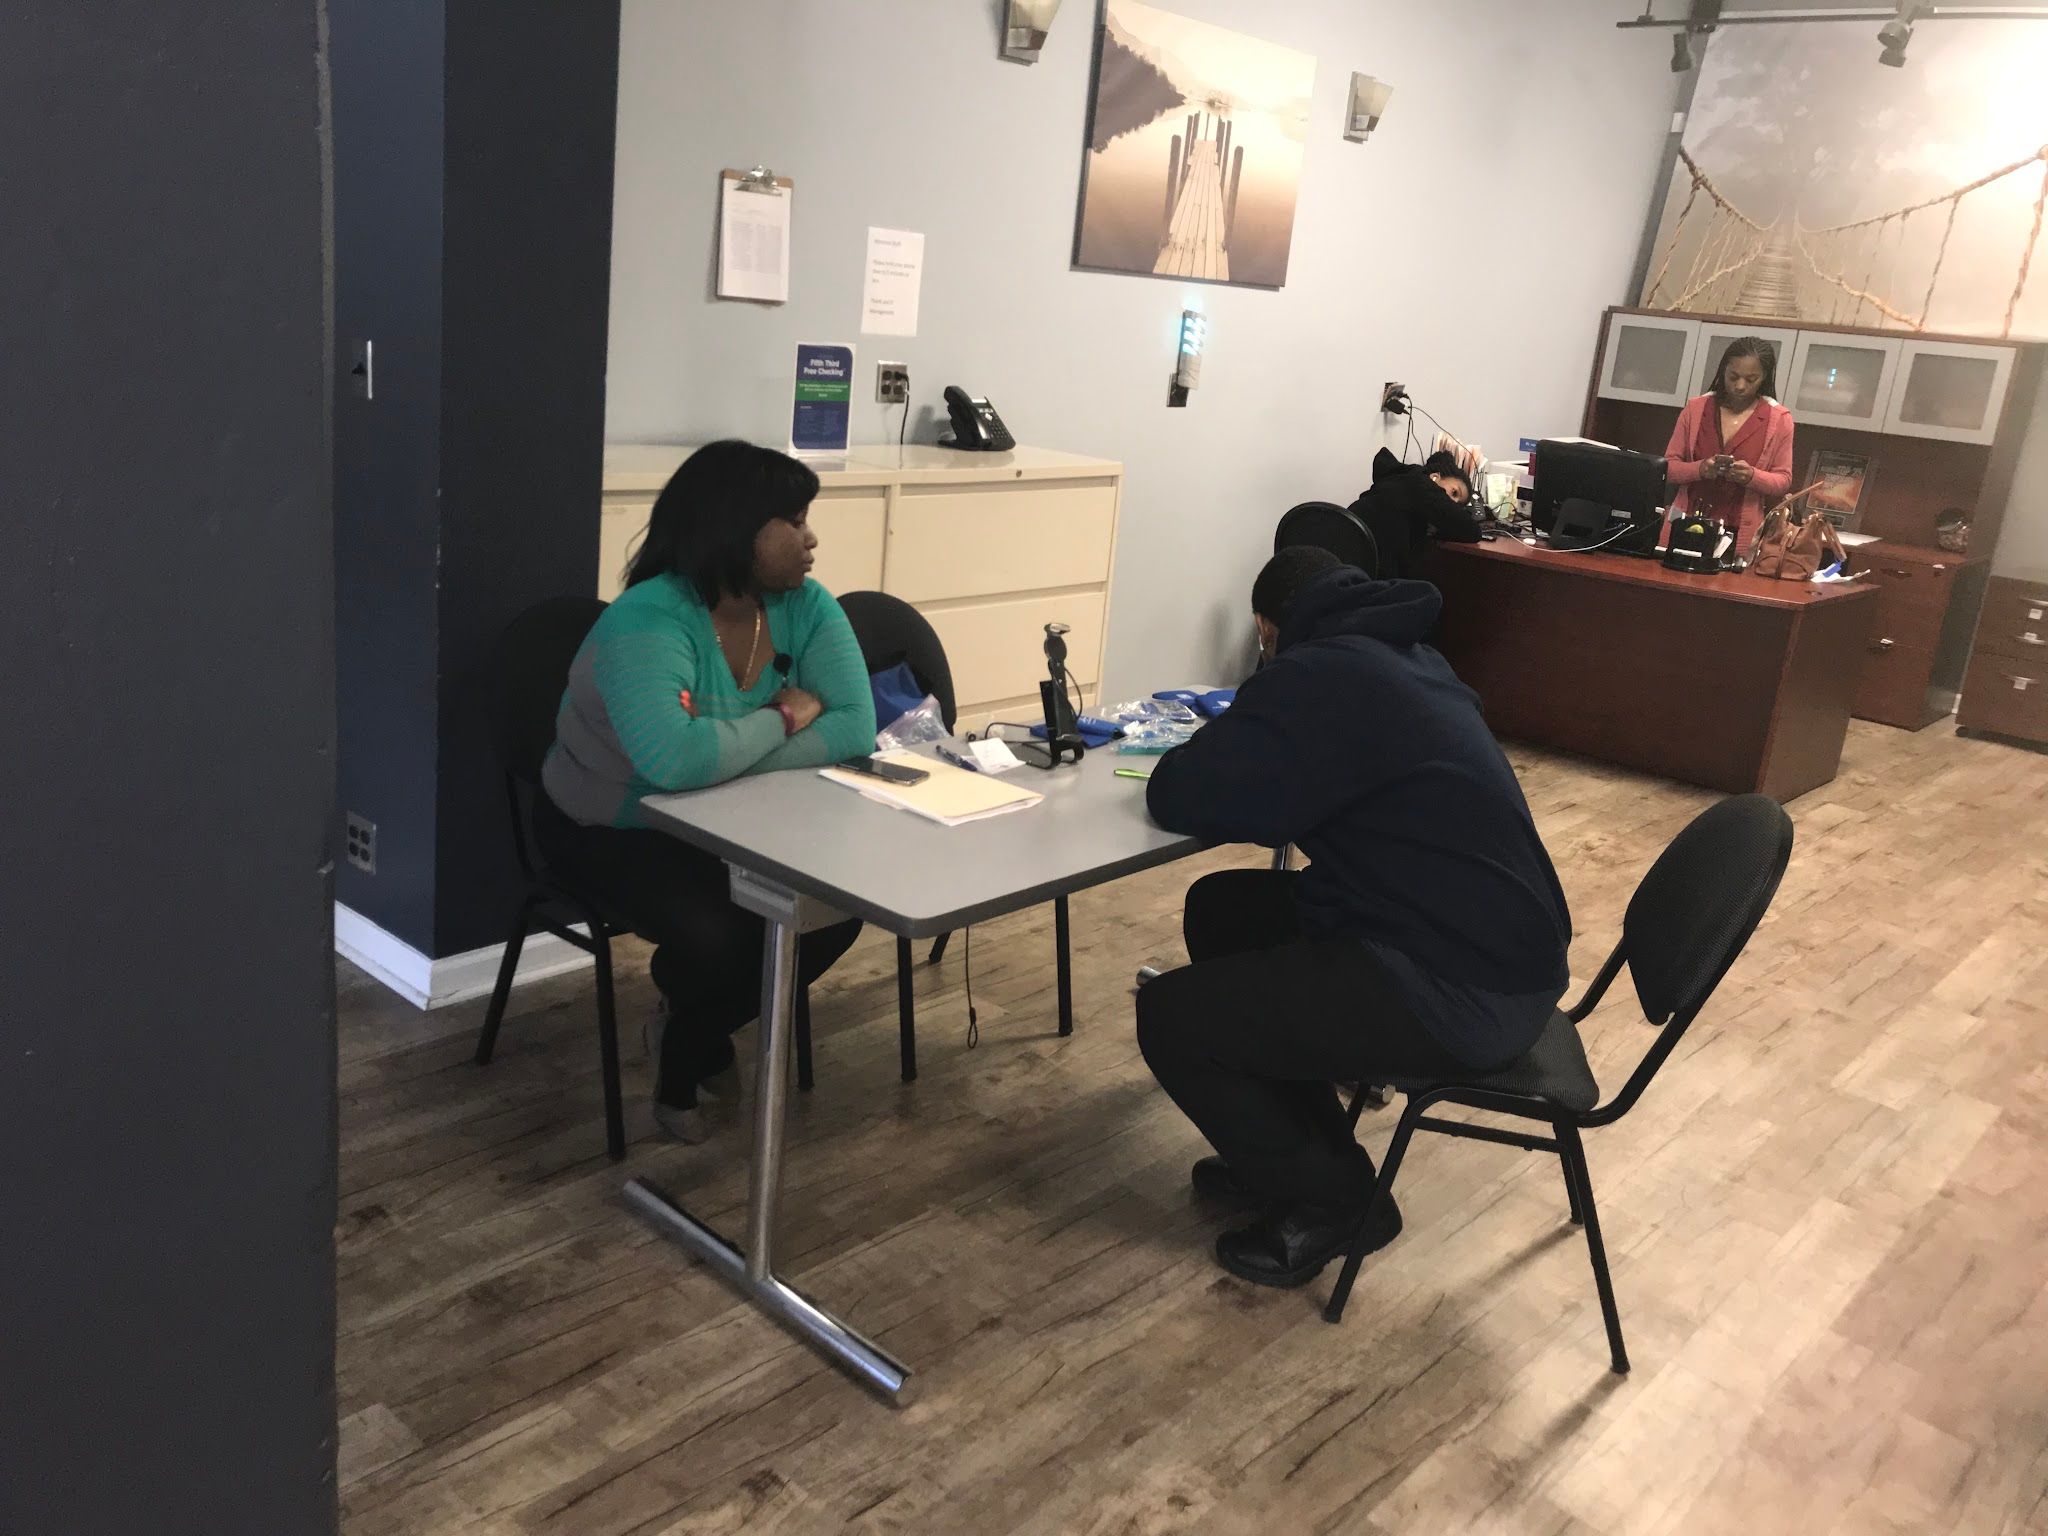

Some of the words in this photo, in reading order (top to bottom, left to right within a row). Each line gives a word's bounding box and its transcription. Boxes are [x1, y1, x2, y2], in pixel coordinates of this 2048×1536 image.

[810, 359, 824, 367] Fifth
[825, 359, 840, 368] Third
[818, 367, 844, 377] Checking
